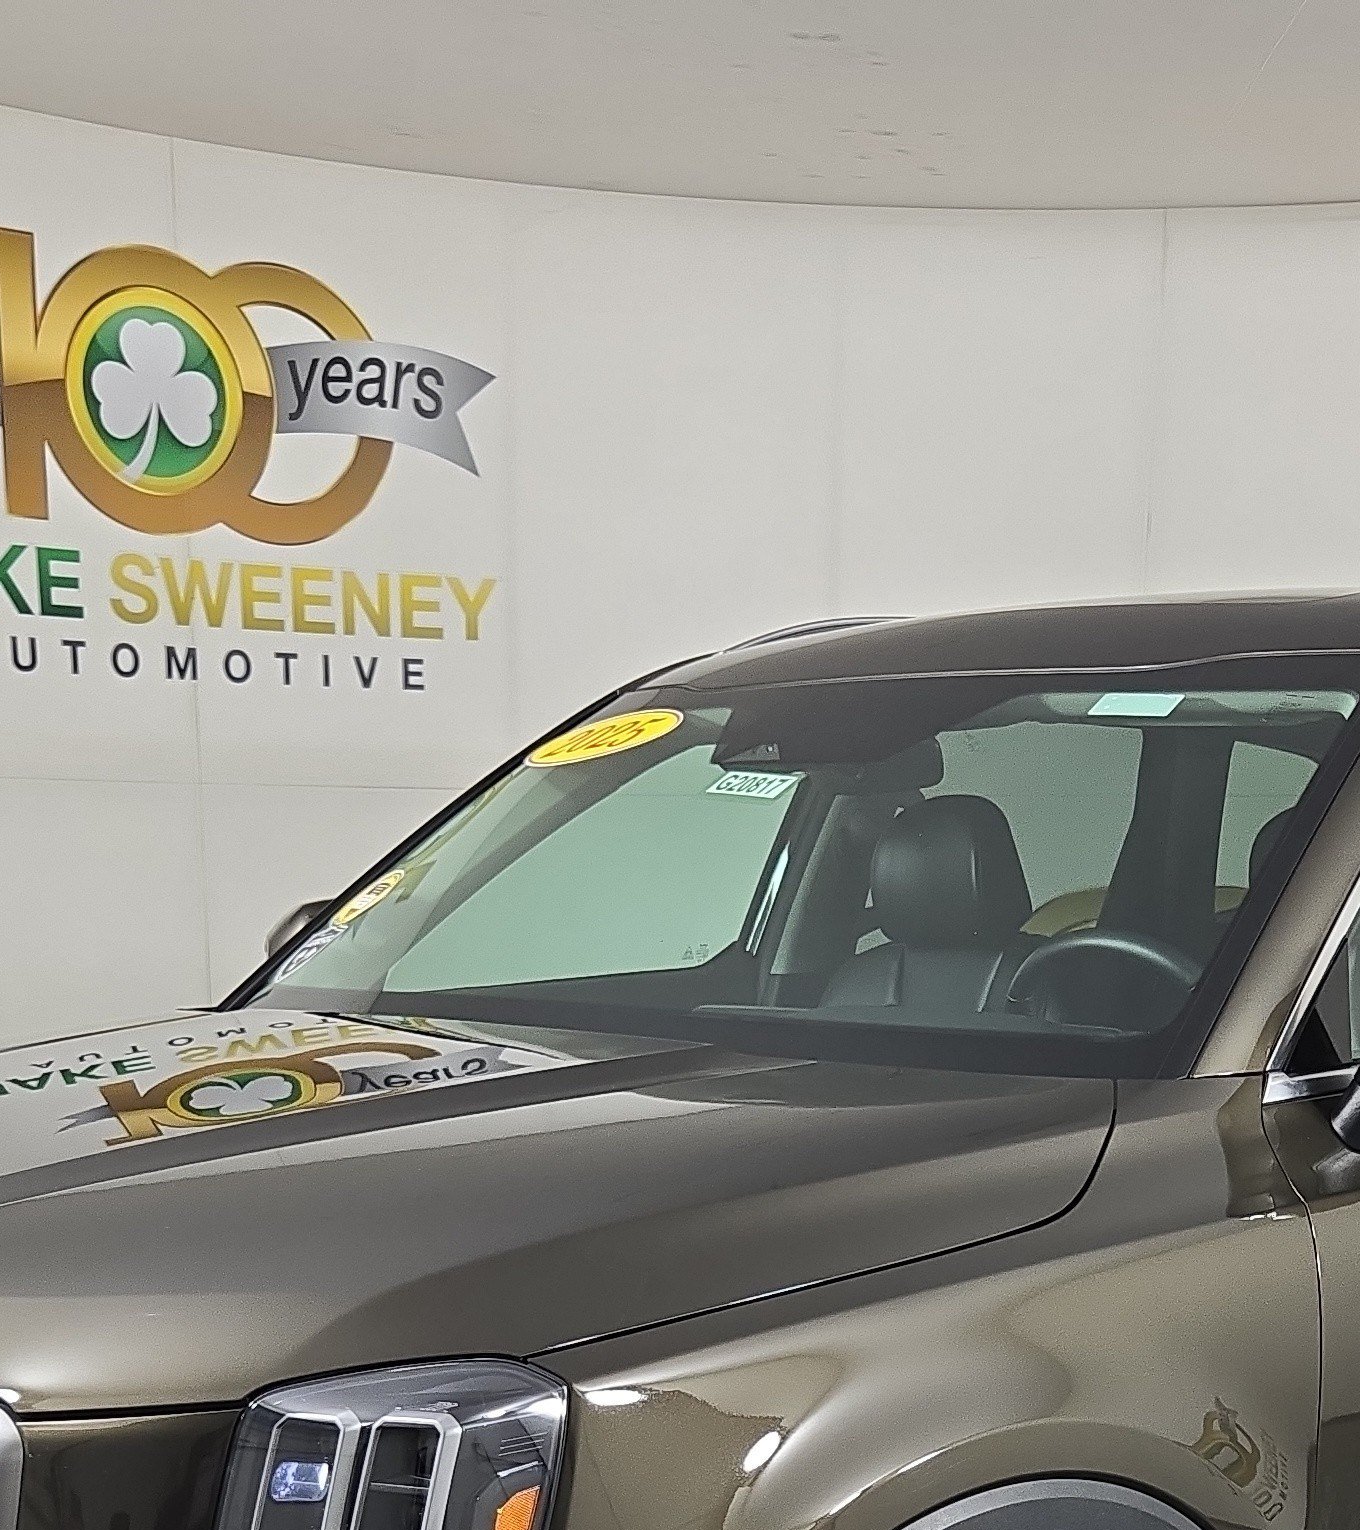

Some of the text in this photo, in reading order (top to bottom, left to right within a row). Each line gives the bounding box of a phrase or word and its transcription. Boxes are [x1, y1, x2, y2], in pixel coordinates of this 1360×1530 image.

[287, 356, 444, 420] years
[109, 553, 497, 641] SWEENEY
[539, 717, 669, 759] 2025
[715, 774, 785, 795] G20817
